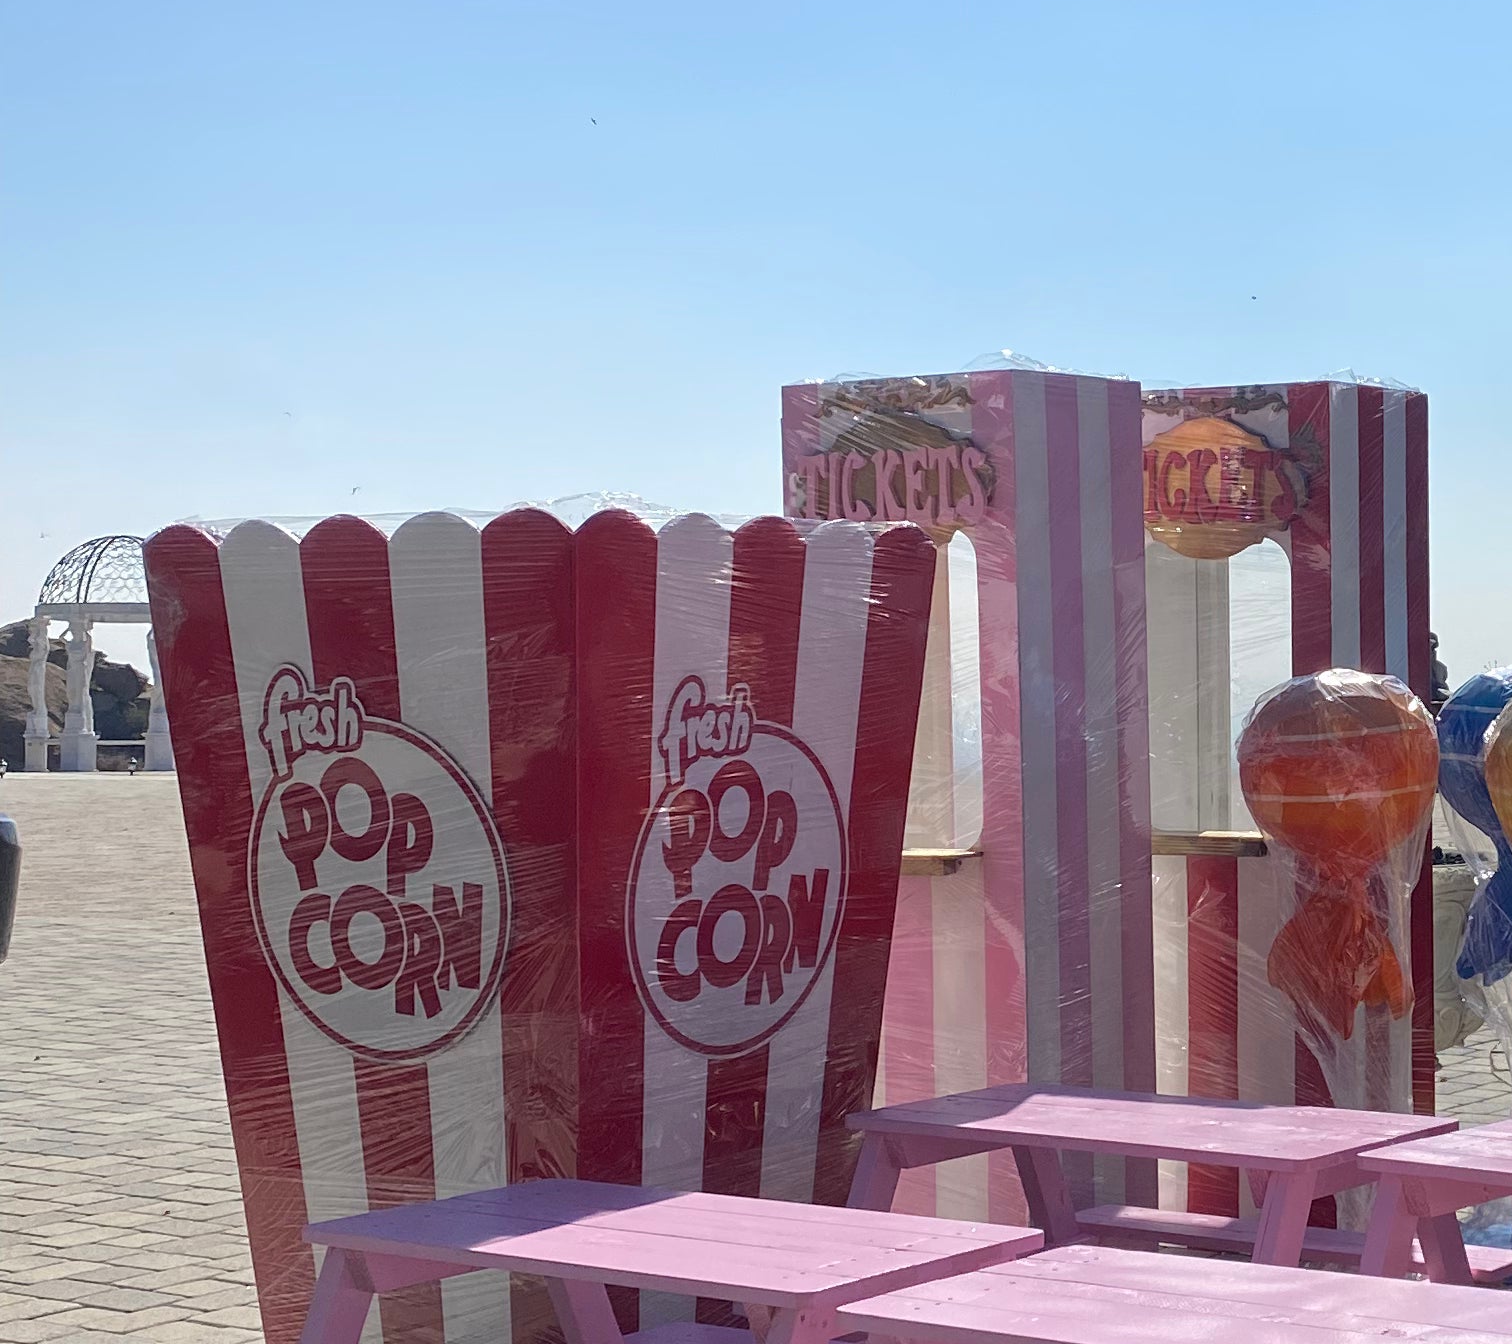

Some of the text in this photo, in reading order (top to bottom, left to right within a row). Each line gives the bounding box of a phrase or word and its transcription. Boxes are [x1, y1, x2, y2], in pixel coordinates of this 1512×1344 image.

[798, 444, 986, 526] TICKETS
[1143, 447, 1298, 524] ICKETS
[263, 672, 360, 778] fresh
[662, 682, 750, 785] fresh
[277, 757, 434, 898] POP
[662, 760, 798, 900] POP
[289, 882, 483, 1020] CORN
[657, 868, 829, 1006] CORN
